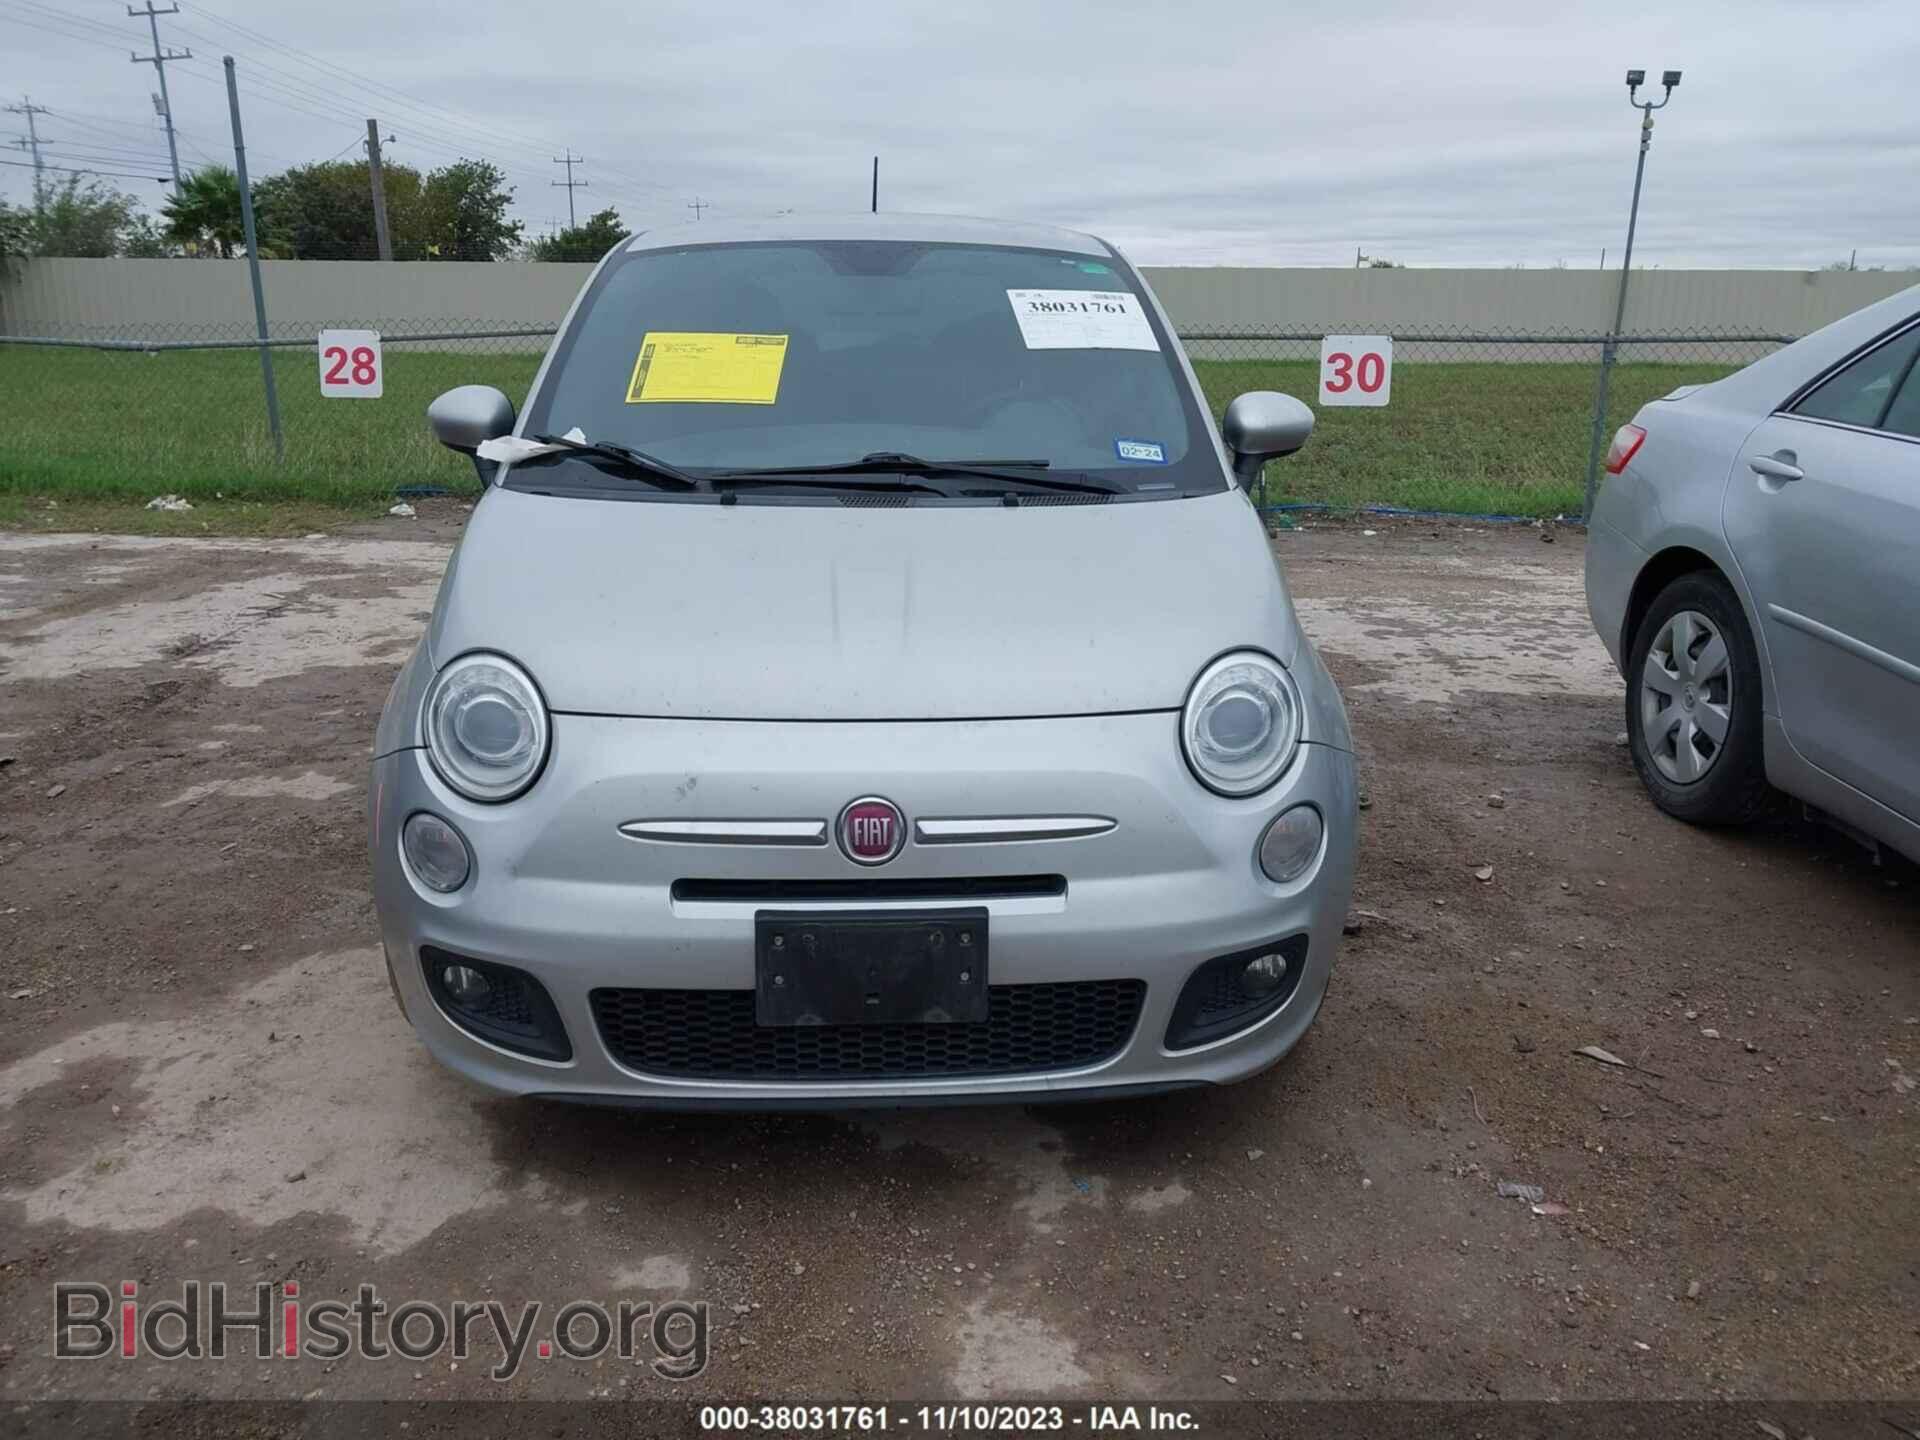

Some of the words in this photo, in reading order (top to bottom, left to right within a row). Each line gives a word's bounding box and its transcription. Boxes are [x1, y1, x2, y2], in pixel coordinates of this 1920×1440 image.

[1028, 302, 1127, 314] 38031761
[324, 346, 376, 385] 28
[1325, 352, 1385, 393] 30
[854, 818, 891, 846] FIAT
